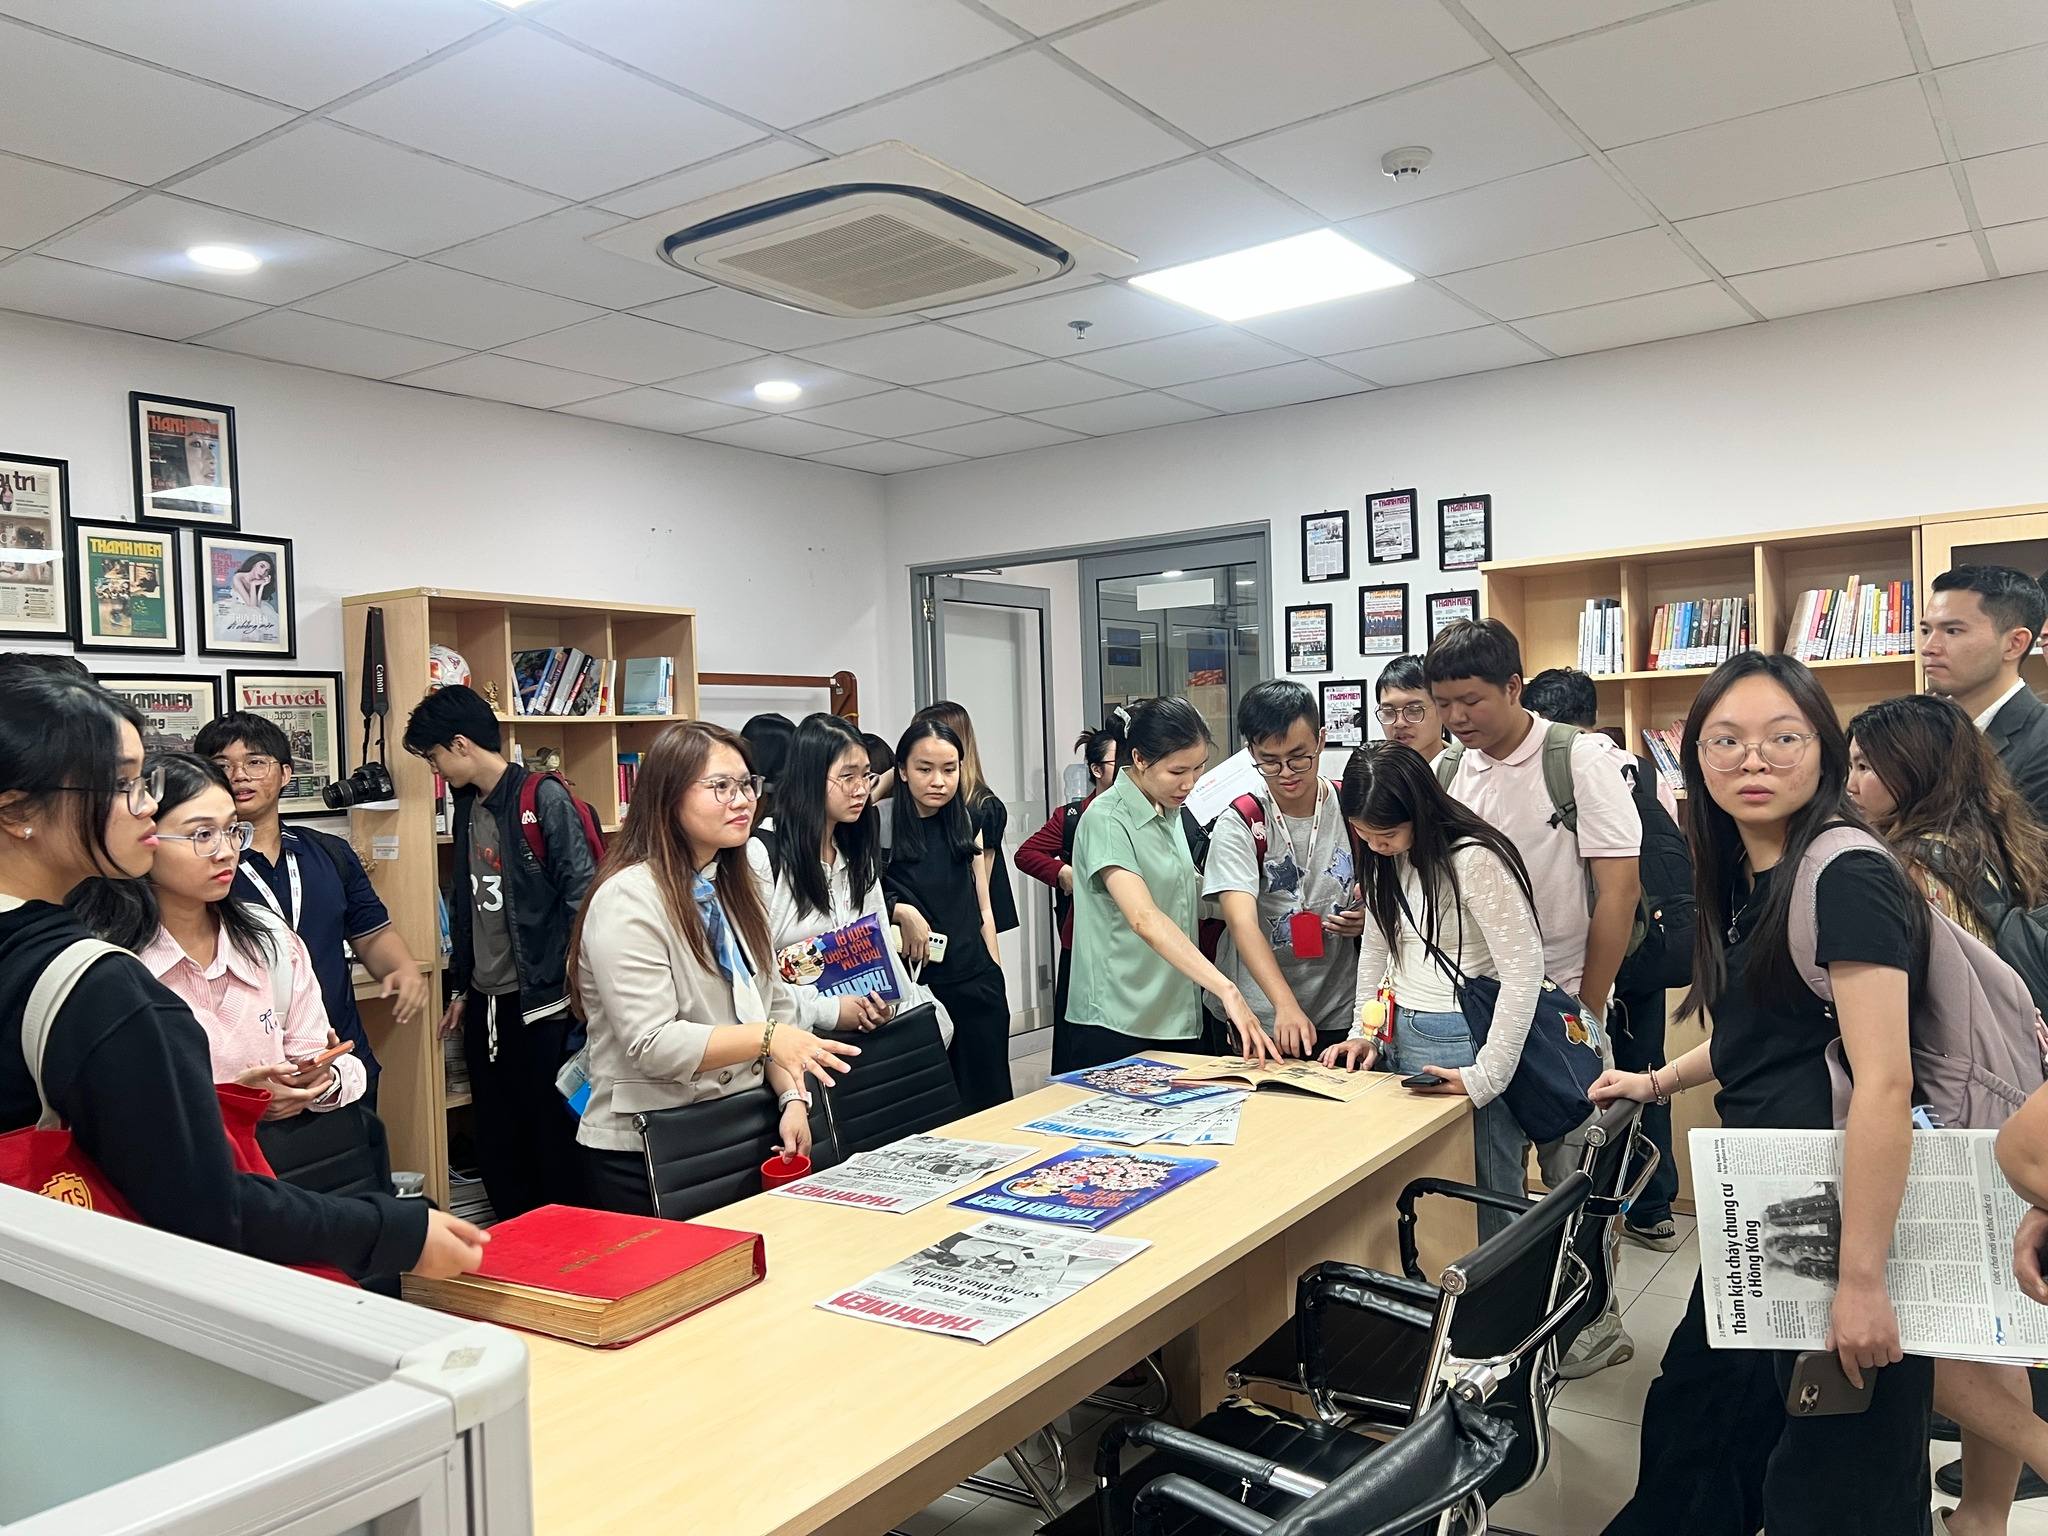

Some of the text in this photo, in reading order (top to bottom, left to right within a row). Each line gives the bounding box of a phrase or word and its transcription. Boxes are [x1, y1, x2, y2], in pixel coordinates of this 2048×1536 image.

[376, 664, 384, 693] Canon
[121, 693, 160, 708] HANH
[243, 690, 326, 706] Vietweek
[144, 715, 165, 729] ing
[1721, 1182, 1747, 1335] Thảm kịch cháy chung cư
[1745, 1220, 1764, 1298] ở Hồng Kông
[912, 1278, 958, 1292] doanh
[958, 1287, 992, 1301] kinh
[886, 1305, 985, 1332] THANH
